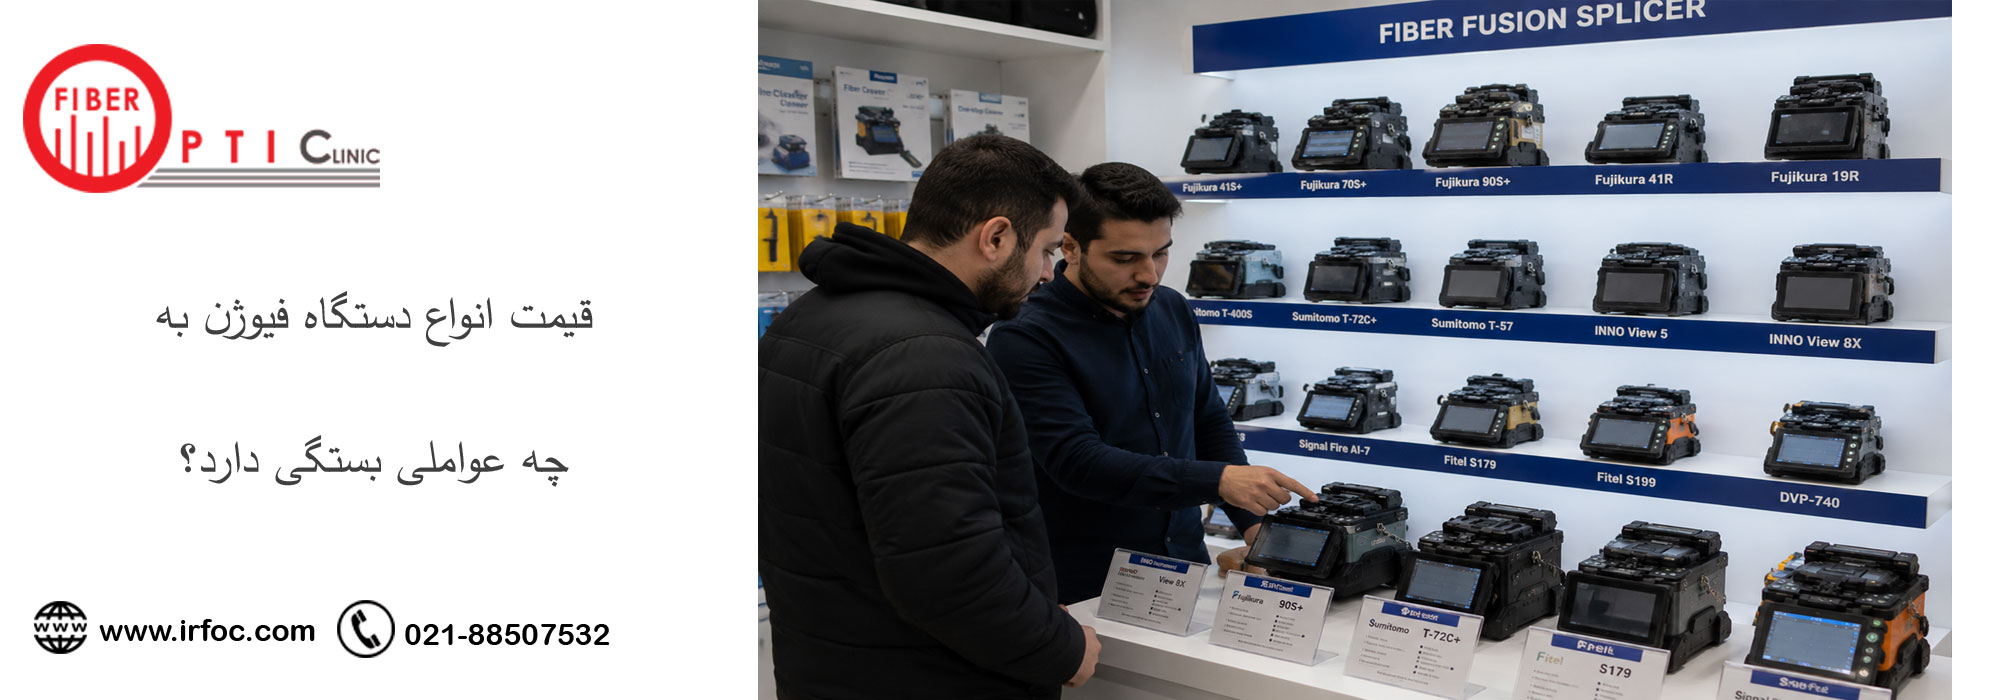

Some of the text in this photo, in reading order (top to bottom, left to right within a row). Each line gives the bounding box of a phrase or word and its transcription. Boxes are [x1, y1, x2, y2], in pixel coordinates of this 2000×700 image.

[1379, 0, 1706, 44] FIBER FUSION SPLICER
[1435, 176, 1511, 190] Fujikura 90S+
[1595, 173, 1674, 188] Fujikura 41R
[1771, 170, 1860, 185] Fujikura 19R
[1182, 182, 1243, 194] Fujikura 41S+
[1300, 179, 1367, 192] Fujikura 70S+
[1193, 307, 1253, 319] itomo T-400S
[1292, 311, 1377, 325] Sumitomo T-72C+
[1431, 317, 1514, 331] Sumitomo T-57
[1594, 325, 1668, 339] INNO View 5
[1769, 333, 1862, 349] INNO View 8X
[1298, 439, 1371, 456] Signal Fire AI-7
[1443, 454, 1497, 470] Fitel S179
[1596, 471, 1656, 488] Fitel S199
[1779, 491, 1840, 509] DVP-740
[1159, 575, 1186, 588] View 8X
[1279, 599, 1303, 612] 90S+
[1368, 618, 1410, 635] Sumitomo
[1423, 628, 1461, 644] T-72C+
[1536, 651, 1564, 666] Fitel
[1599, 663, 1632, 679] S179
